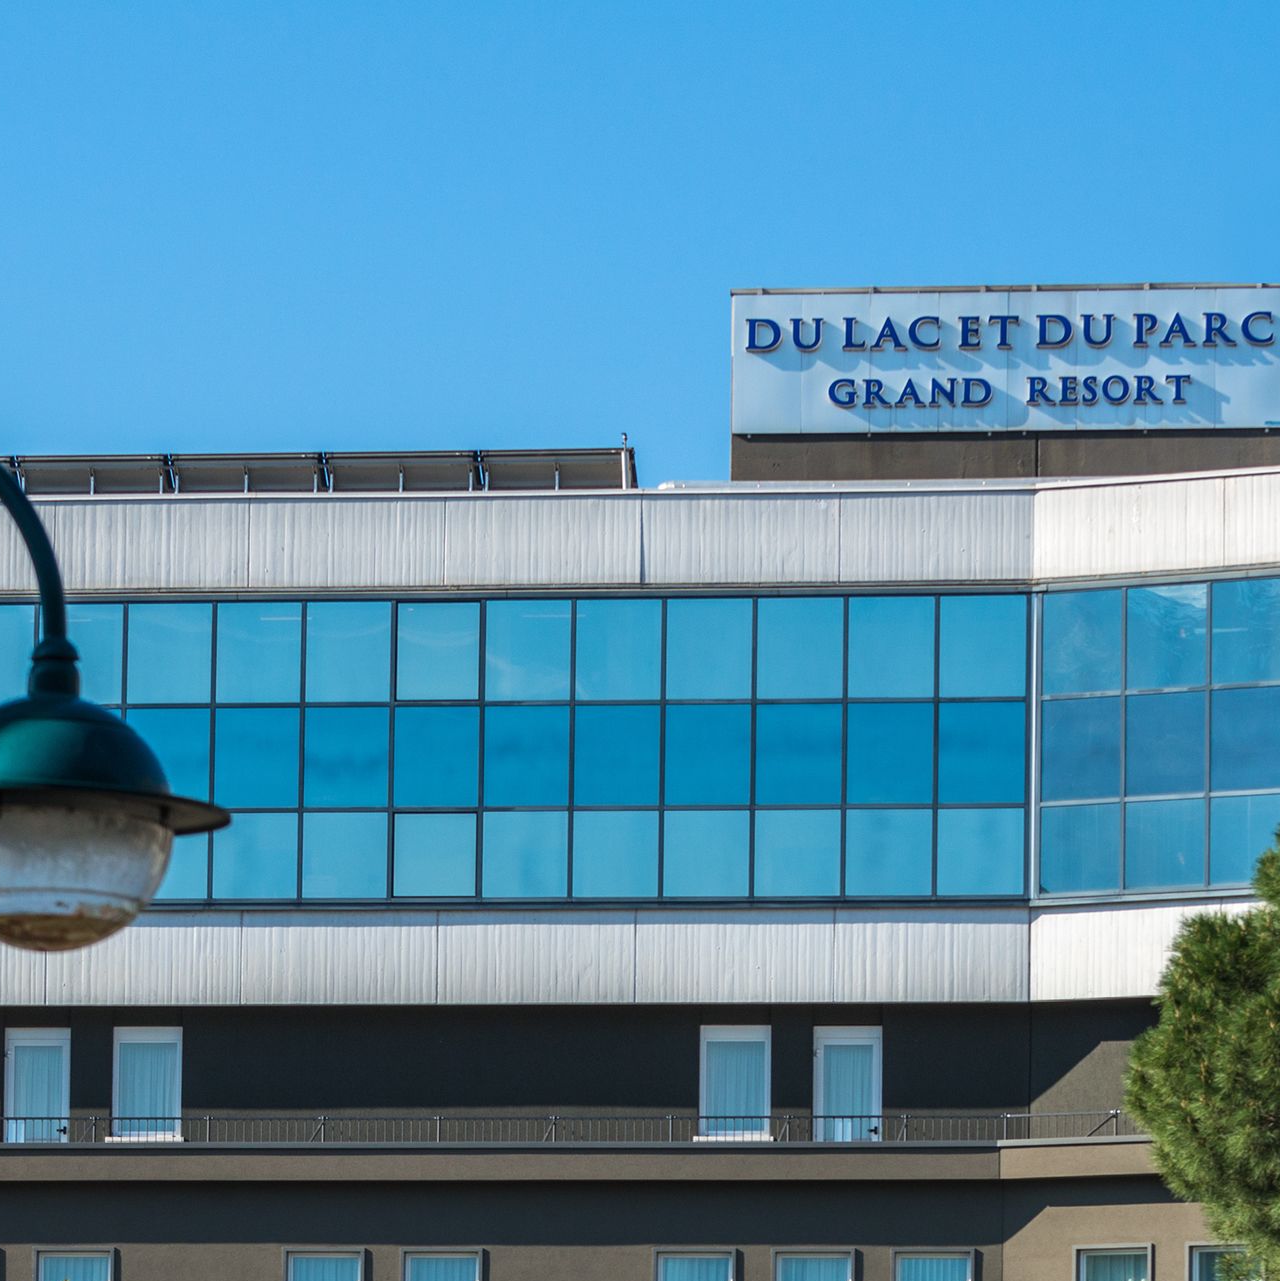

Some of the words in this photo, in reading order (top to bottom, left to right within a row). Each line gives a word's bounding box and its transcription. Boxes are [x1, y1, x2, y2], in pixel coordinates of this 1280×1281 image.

[745, 317, 825, 352] DU
[841, 315, 942, 351] LAC
[958, 314, 1020, 350] ET
[1036, 313, 1117, 349] DU
[1132, 311, 1275, 348] PARC
[827, 377, 994, 409] GRAND
[1025, 374, 1193, 406] RESORT
